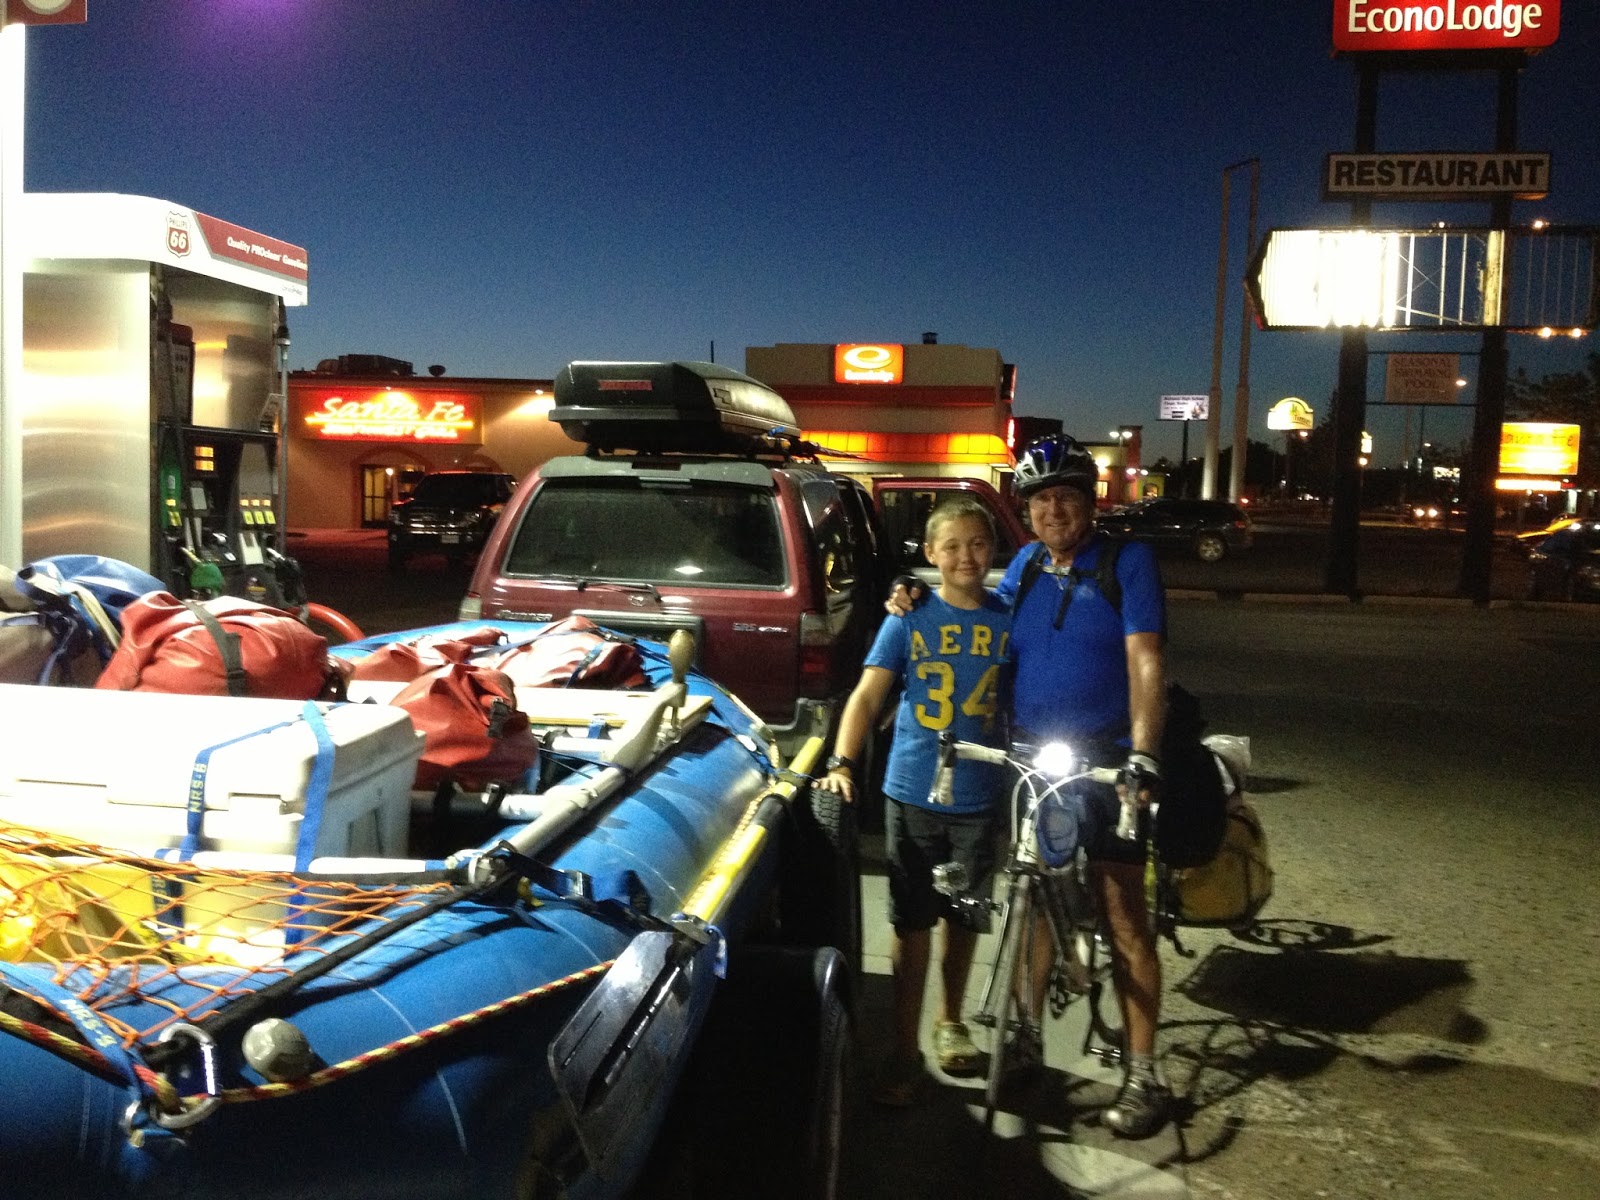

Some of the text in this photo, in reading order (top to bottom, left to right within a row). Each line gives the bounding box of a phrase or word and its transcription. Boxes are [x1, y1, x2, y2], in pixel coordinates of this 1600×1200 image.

[1348, 0, 1542, 37] EconoLodge
[1334, 160, 1544, 187] RESTAURANT
[170, 230, 187, 249] 66
[227, 236, 251, 253] Quality
[314, 397, 465, 421] Santa Fe
[915, 661, 1000, 731] 34
